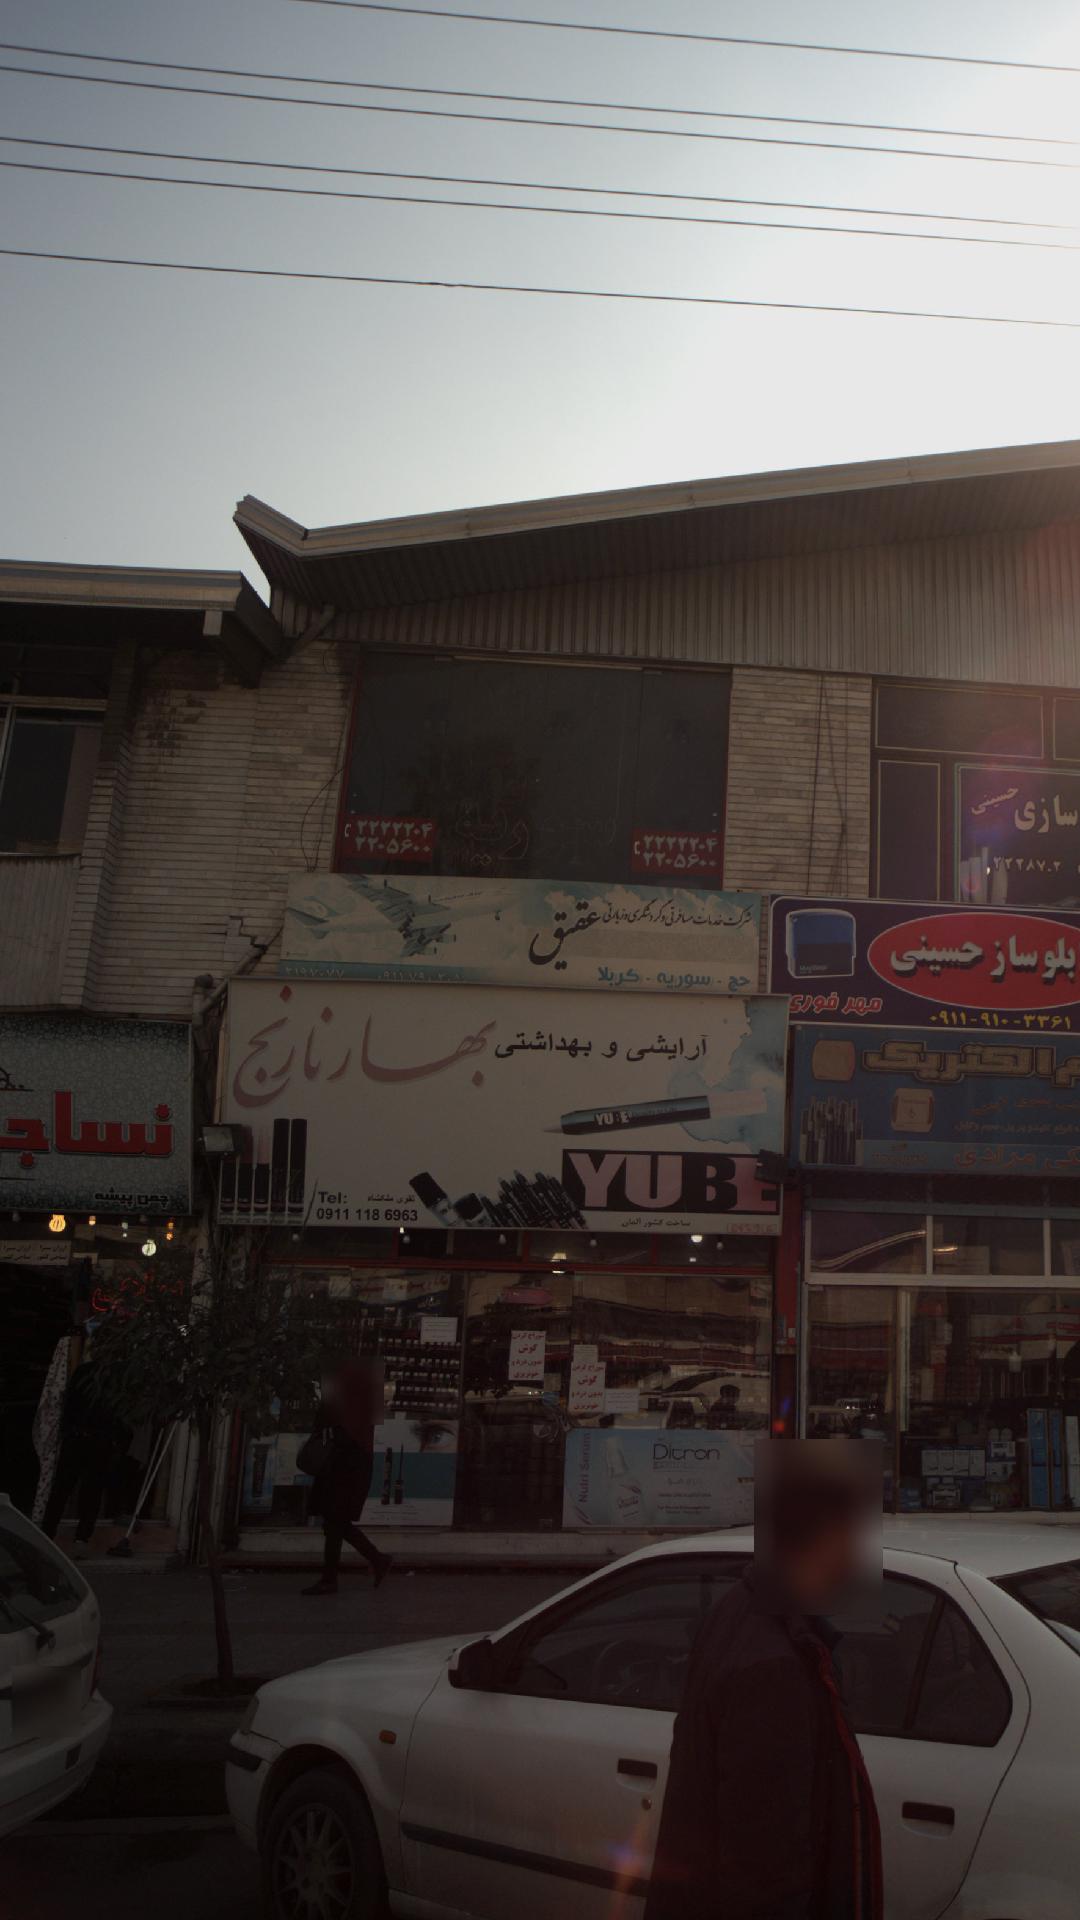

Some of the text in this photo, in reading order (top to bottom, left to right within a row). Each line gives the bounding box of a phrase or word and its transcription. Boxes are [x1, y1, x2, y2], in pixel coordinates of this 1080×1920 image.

[970, 787, 1019, 816] حسینی
[692, 907, 723, 927] خدمات
[722, 903, 754, 929] شرکت
[528, 901, 601, 971] عقیق
[890, 933, 984, 974] حسینی
[597, 966, 751, 992] حج سوریه کربلا
[789, 991, 884, 1017] مهر فوری
[494, 1030, 709, 1062] آرایشی و بهداشتی
[567, 1151, 779, 1212] YUBE
[318, 1191, 348, 1205] Tel:
[316, 1207, 418, 1222] 0911 118 6963
